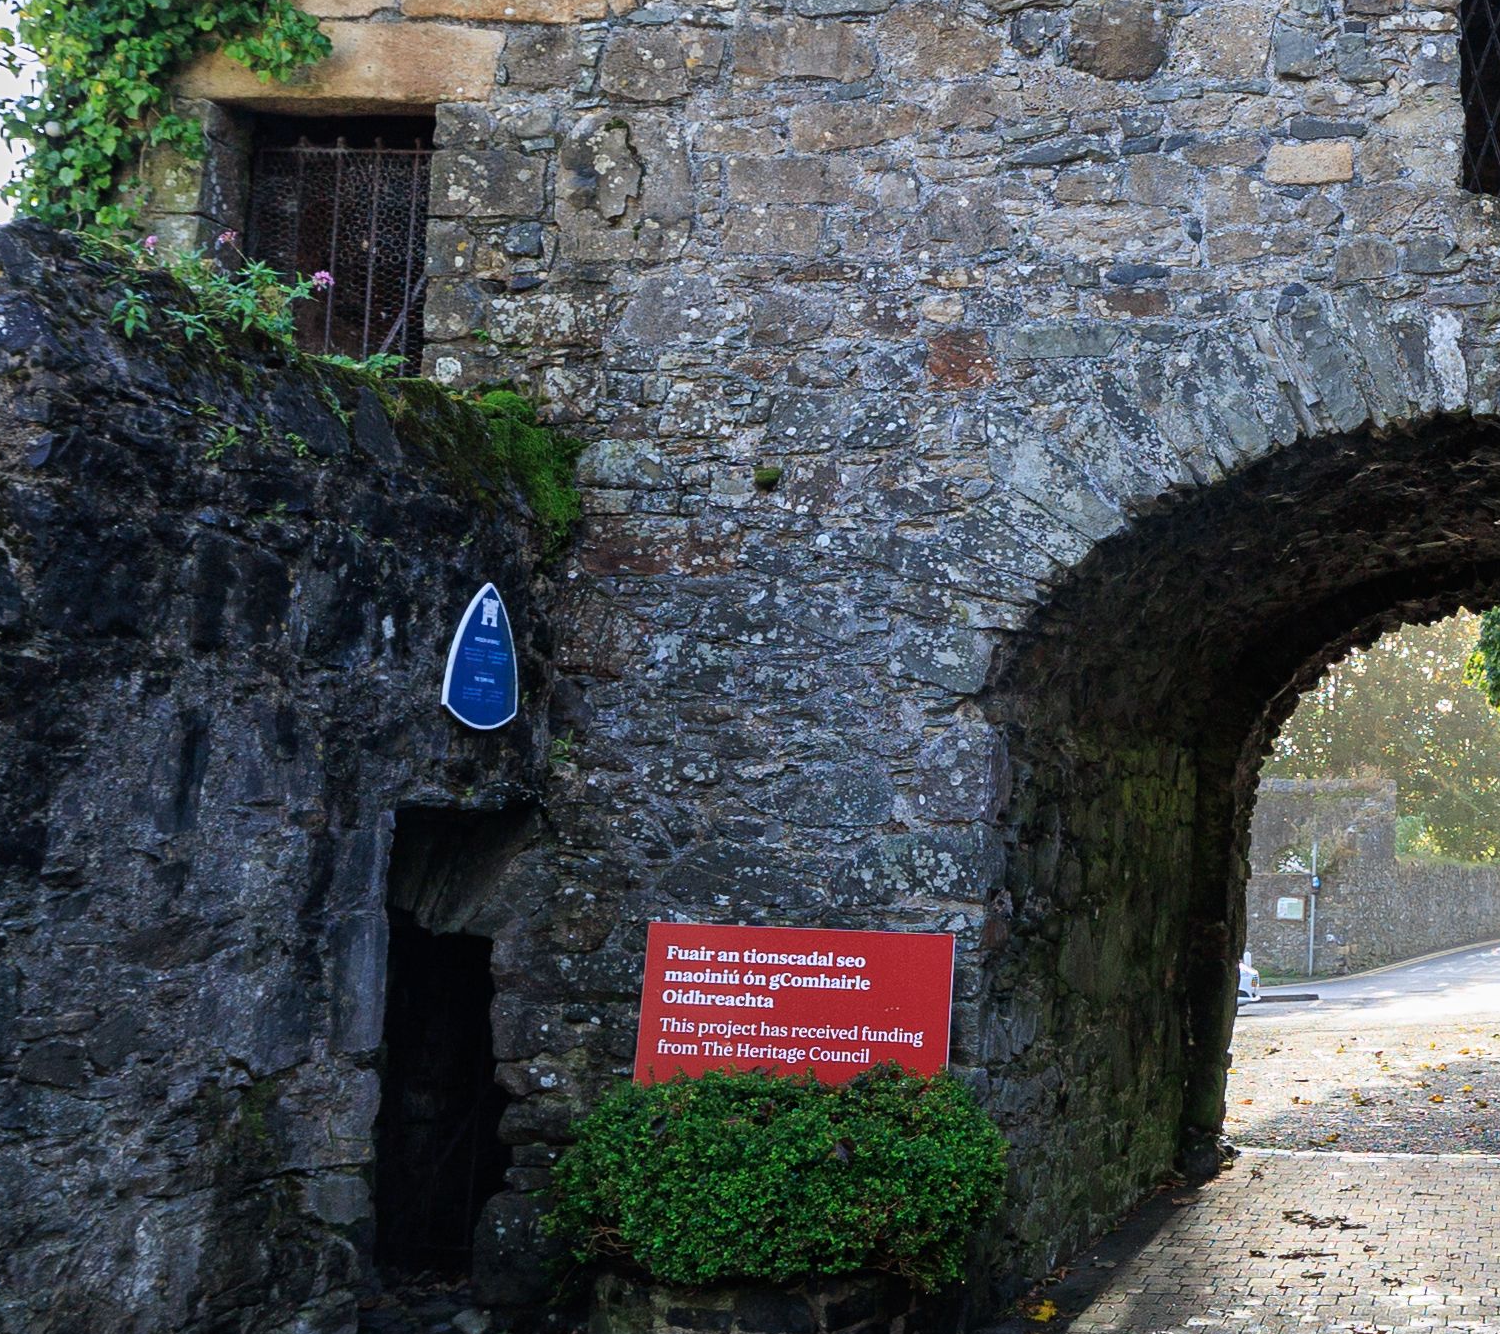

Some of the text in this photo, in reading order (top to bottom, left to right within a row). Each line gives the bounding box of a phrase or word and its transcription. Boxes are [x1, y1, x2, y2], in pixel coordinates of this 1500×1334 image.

[666, 945, 867, 969] Fuair an tionscadal seo
[663, 968, 871, 991] maoiniú ón gComhairle
[662, 988, 774, 1009] Oidhreachta
[660, 1016, 924, 1048] This project has received funding
[656, 1038, 870, 1064] from The Heritage Council
